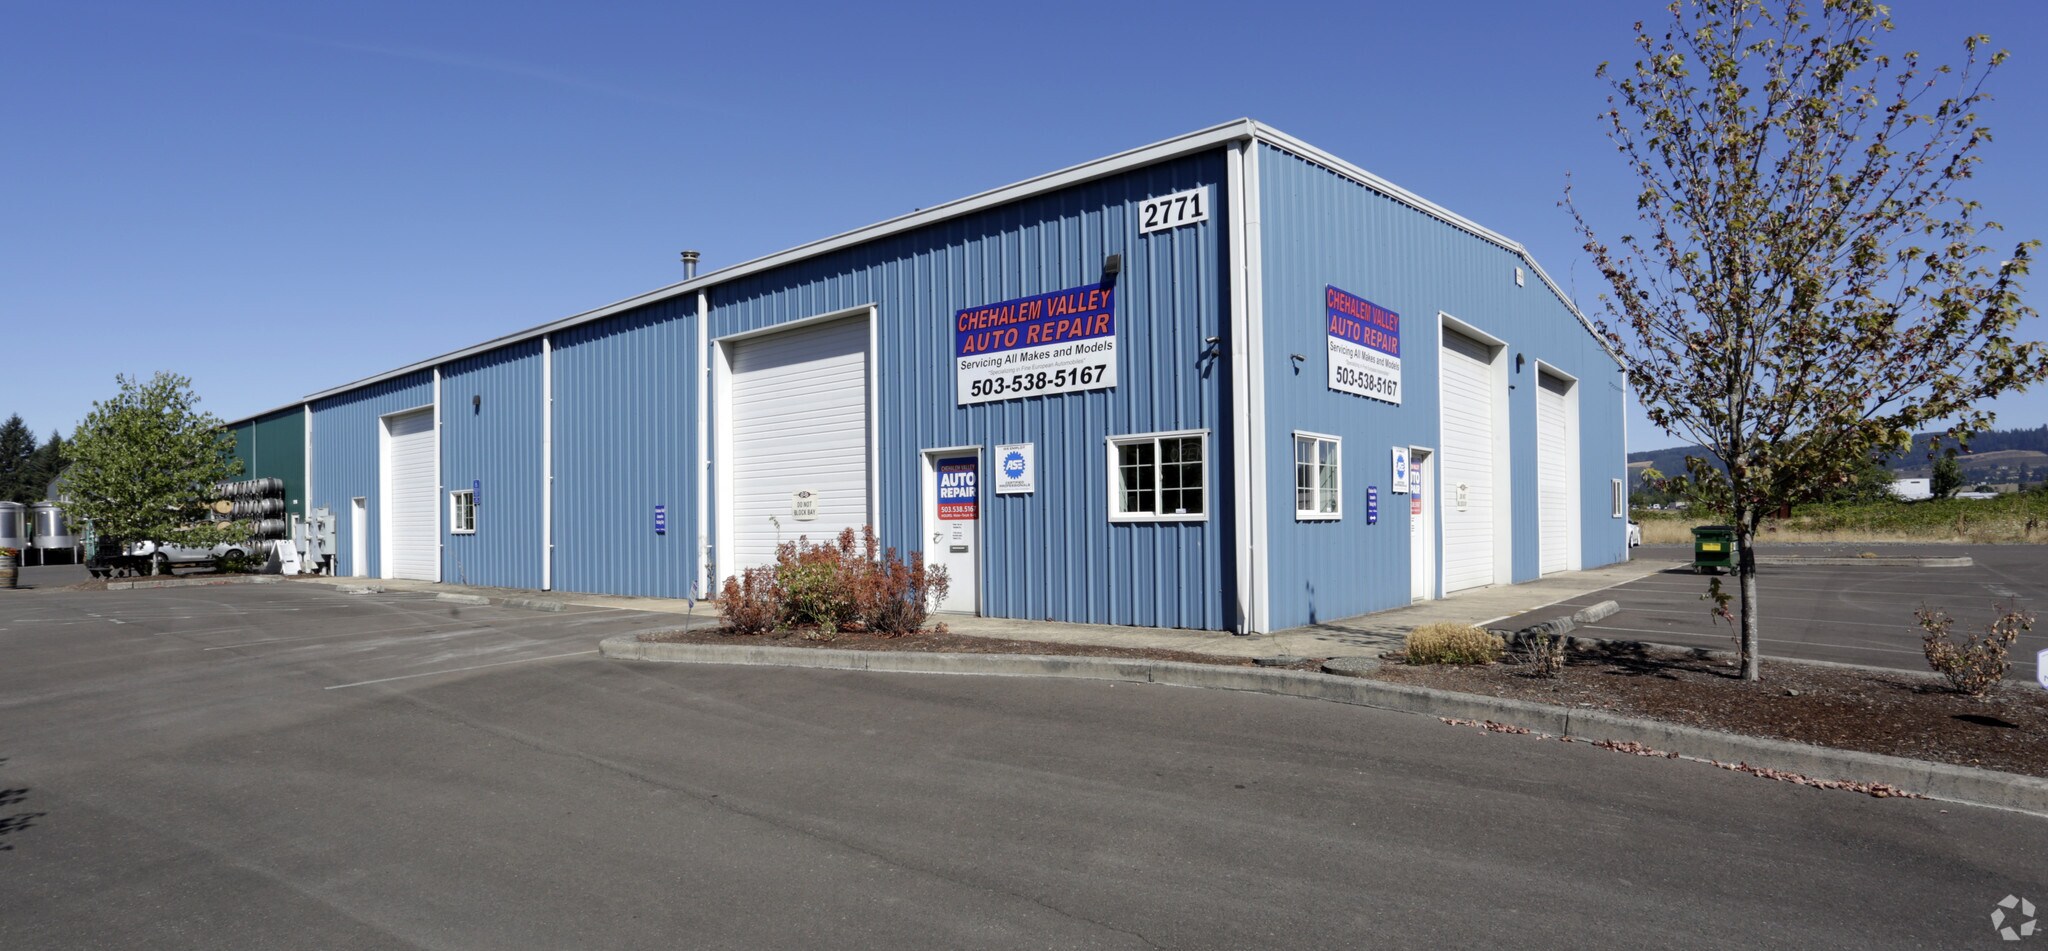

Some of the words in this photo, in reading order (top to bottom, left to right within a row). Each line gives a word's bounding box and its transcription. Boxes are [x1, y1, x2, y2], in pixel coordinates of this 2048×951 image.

[1144, 192, 1203, 228] 2771
[958, 298, 1042, 332] CHEHALEM
[1047, 287, 1112, 317] VALLEY
[1327, 288, 1371, 322] CHEHALEM
[1372, 305, 1400, 332] VALLEY
[962, 328, 1019, 354] AUTO
[1026, 313, 1110, 344] REPAIR
[1329, 315, 1361, 341] AUTO
[1363, 326, 1398, 354] REPAIR
[960, 357, 1003, 371] Servicing
[1004, 353, 1017, 365] All
[1019, 350, 1050, 362] Makes
[1053, 346, 1072, 358] and
[1075, 340, 1113, 355] Models
[1329, 341, 1354, 359] Servicing
[1361, 350, 1376, 364] Makes
[1376, 357, 1385, 366] and
[1384, 359, 1400, 371] Models
[971, 364, 1107, 397] 503-538-5167
[1335, 365, 1398, 397] 503-538-5167
[941, 472, 976, 487] AUTO
[1006, 459, 1023, 471] ASE
[940, 486, 976, 499] REPAIR
[941, 505, 976, 513] 503.538.5167
